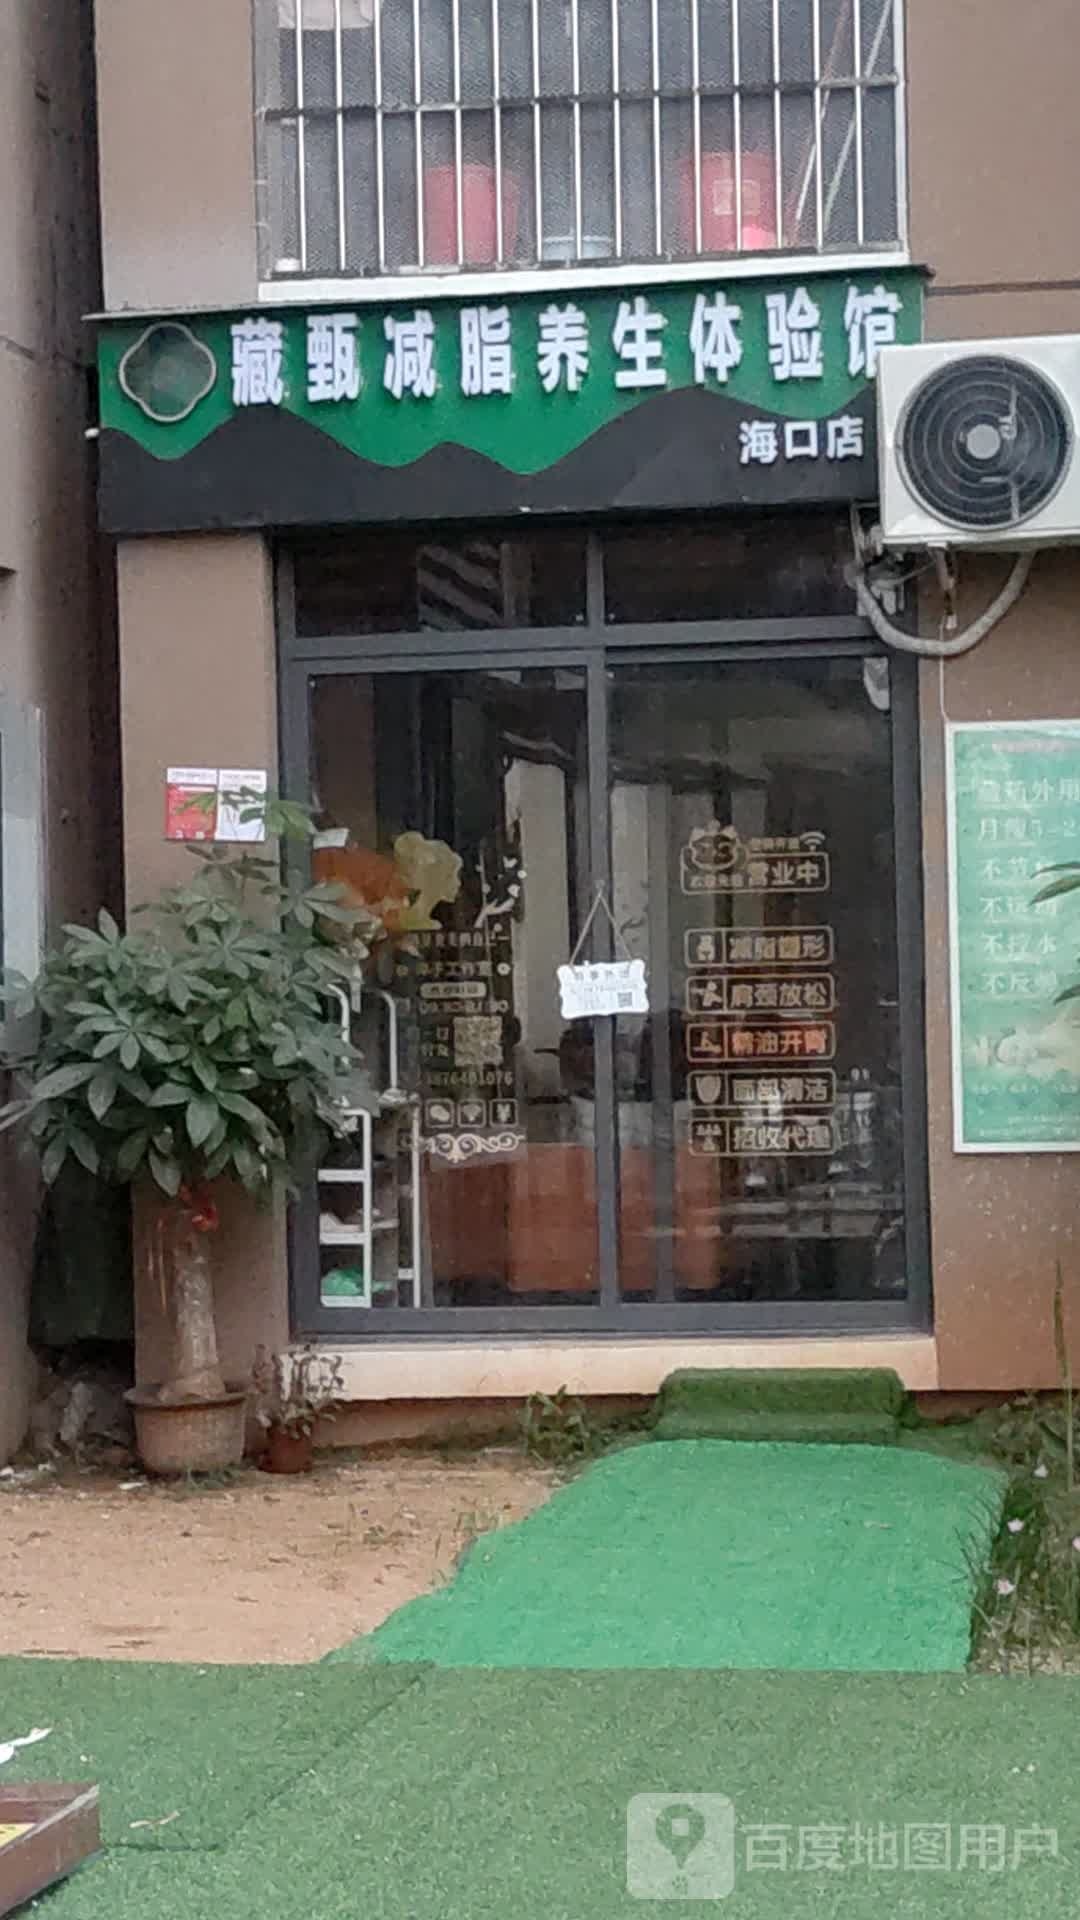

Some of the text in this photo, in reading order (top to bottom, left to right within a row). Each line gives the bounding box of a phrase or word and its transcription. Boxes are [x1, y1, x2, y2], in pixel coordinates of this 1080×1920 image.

[229, 284, 904, 406] 藏甄减脂养生体验馆
[739, 415, 864, 465] 海口店
[747, 860, 820, 887] 营业中
[730, 982, 828, 1008] 肩颈放松
